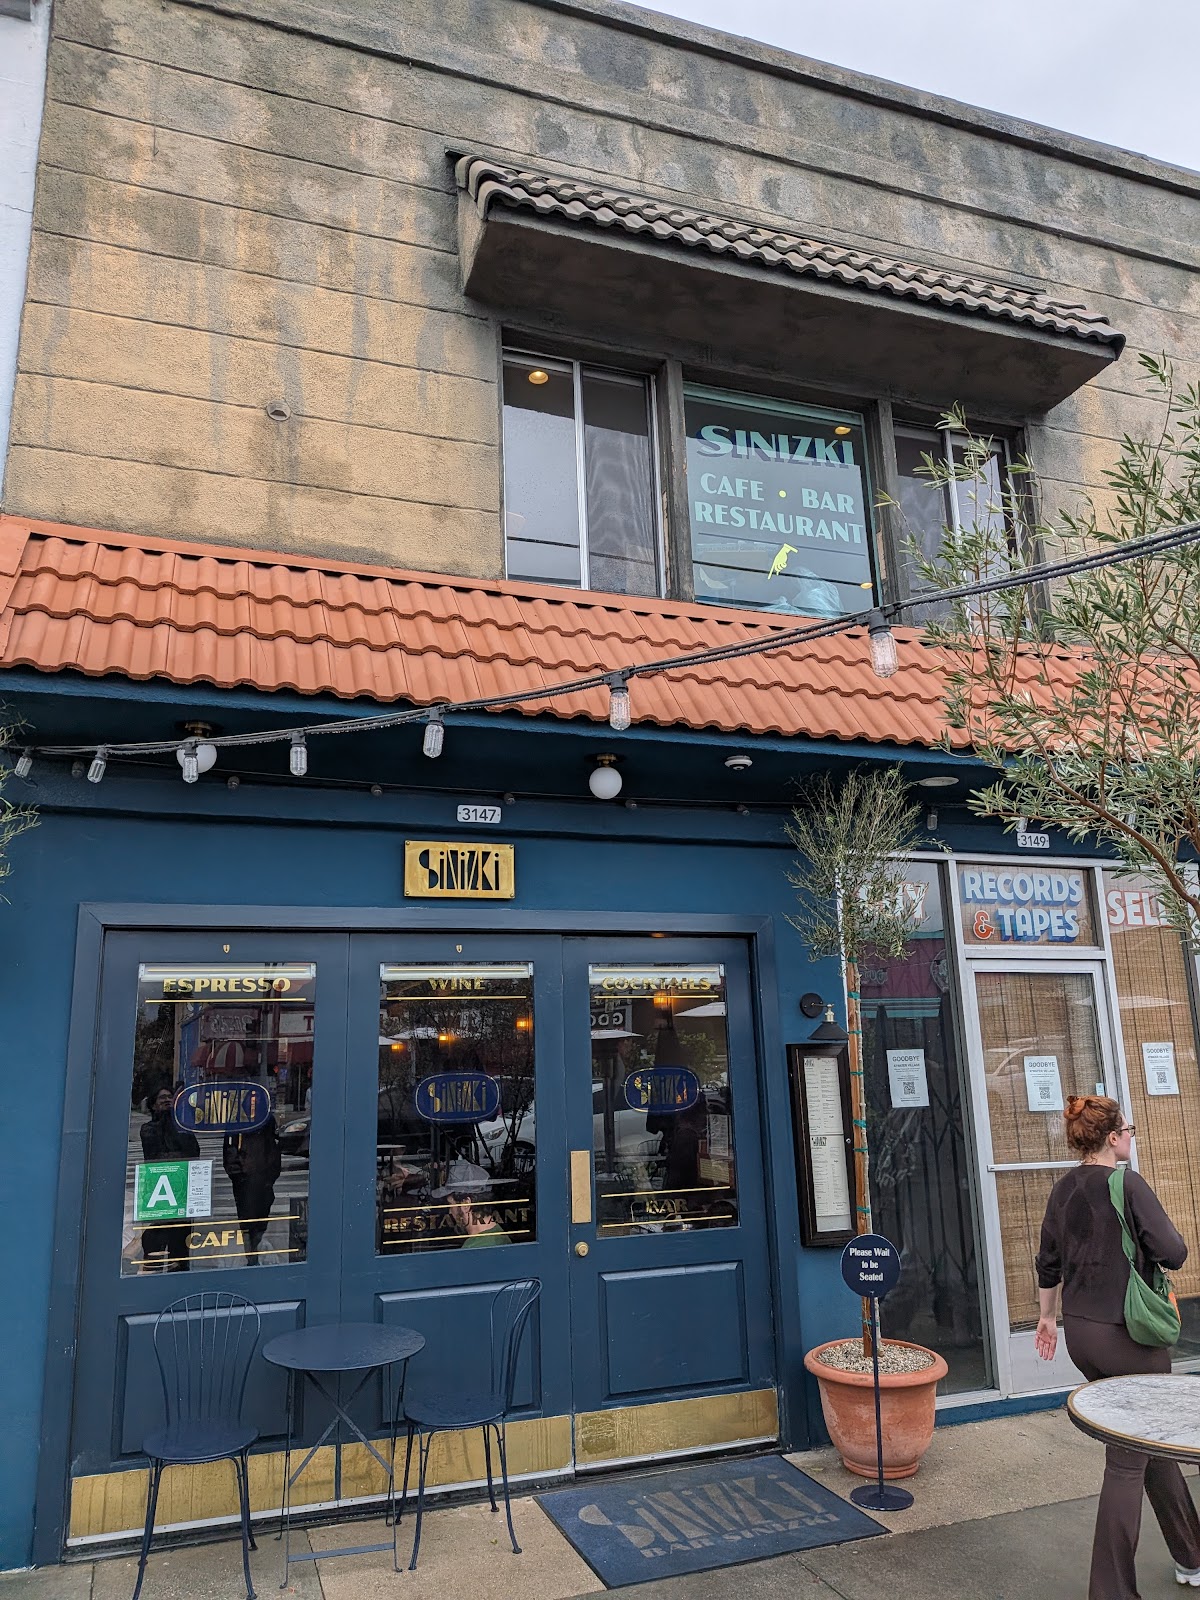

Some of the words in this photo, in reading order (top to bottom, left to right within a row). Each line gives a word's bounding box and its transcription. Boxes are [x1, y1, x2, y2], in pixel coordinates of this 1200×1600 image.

[697, 425, 855, 468] SINIZKI
[700, 472, 765, 501] CAFE
[801, 488, 855, 514] BAR
[694, 501, 864, 544] RESTAURANT
[461, 807, 497, 822] 3147
[1019, 833, 1048, 848] 3149
[963, 869, 1084, 907] RECORDS
[973, 909, 995, 940] &
[997, 907, 1080, 942] TAPES
[162, 977, 291, 993] ESPRESSO
[428, 976, 486, 991] WINE
[602, 976, 712, 991] COCKTAILS
[146, 1174, 178, 1208] A
[383, 1207, 531, 1234] RESTAURANT
[849, 1247, 873, 1257] Please
[873, 1247, 890, 1257] Wait
[861, 1260, 869, 1269] to
[870, 1260, 879, 1269] be
[859, 1273, 884, 1282] Seated
[640, 1538, 716, 1558] BAR
